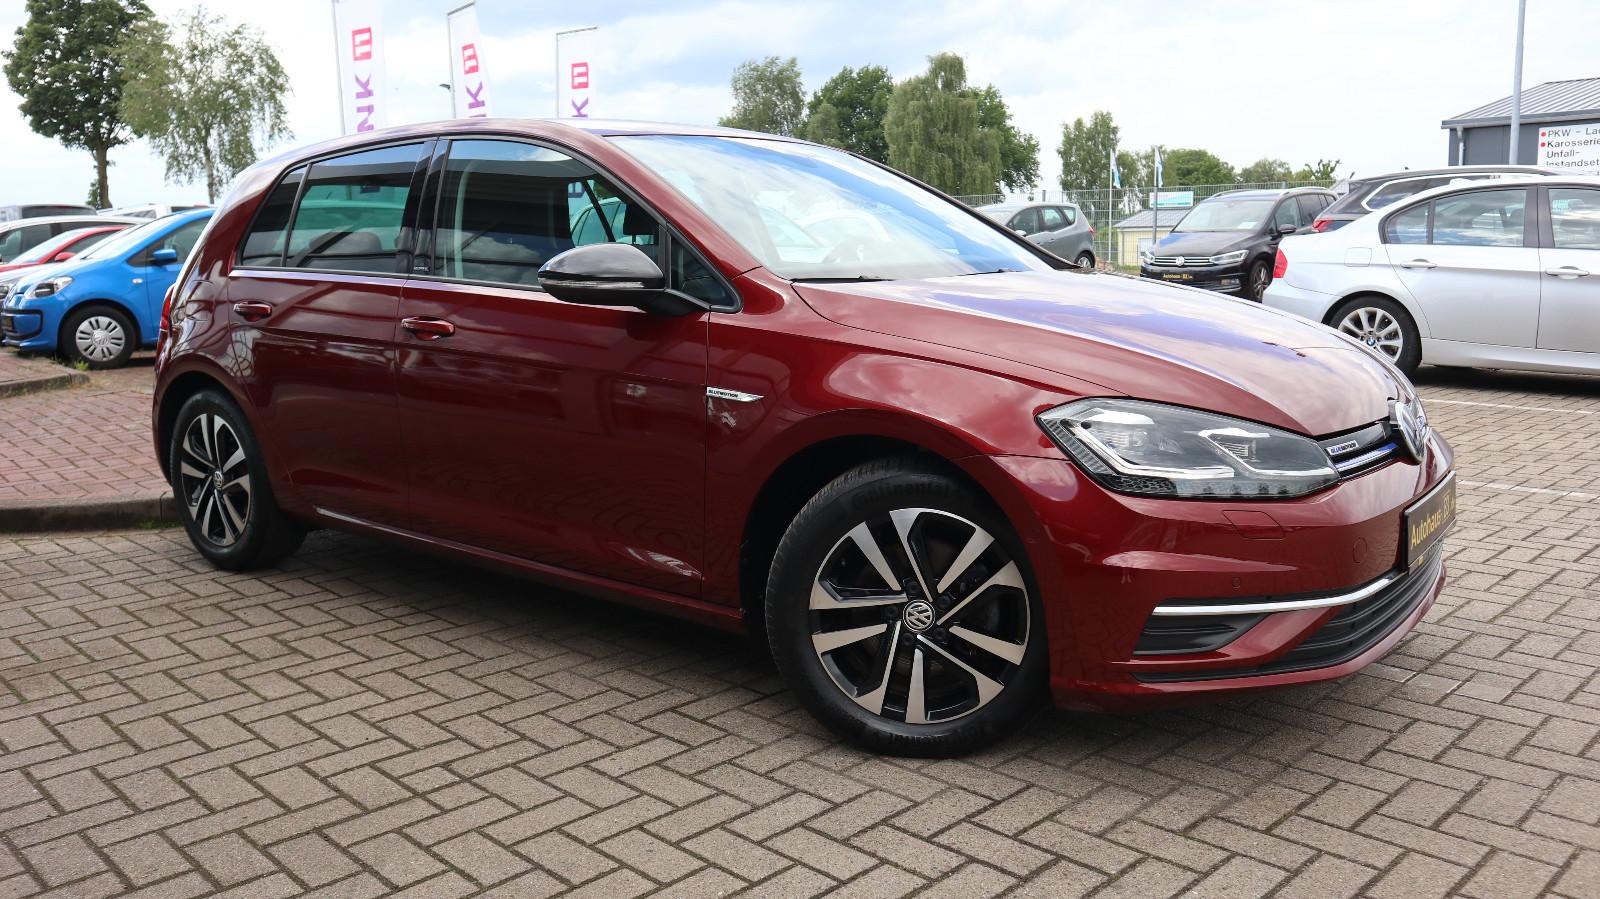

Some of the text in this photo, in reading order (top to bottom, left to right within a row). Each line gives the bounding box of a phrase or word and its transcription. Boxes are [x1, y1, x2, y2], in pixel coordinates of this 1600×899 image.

[1548, 128, 1571, 136] PKW
[1547, 149, 1580, 158] Unfall-
[1410, 509, 1441, 550] Autohaus
